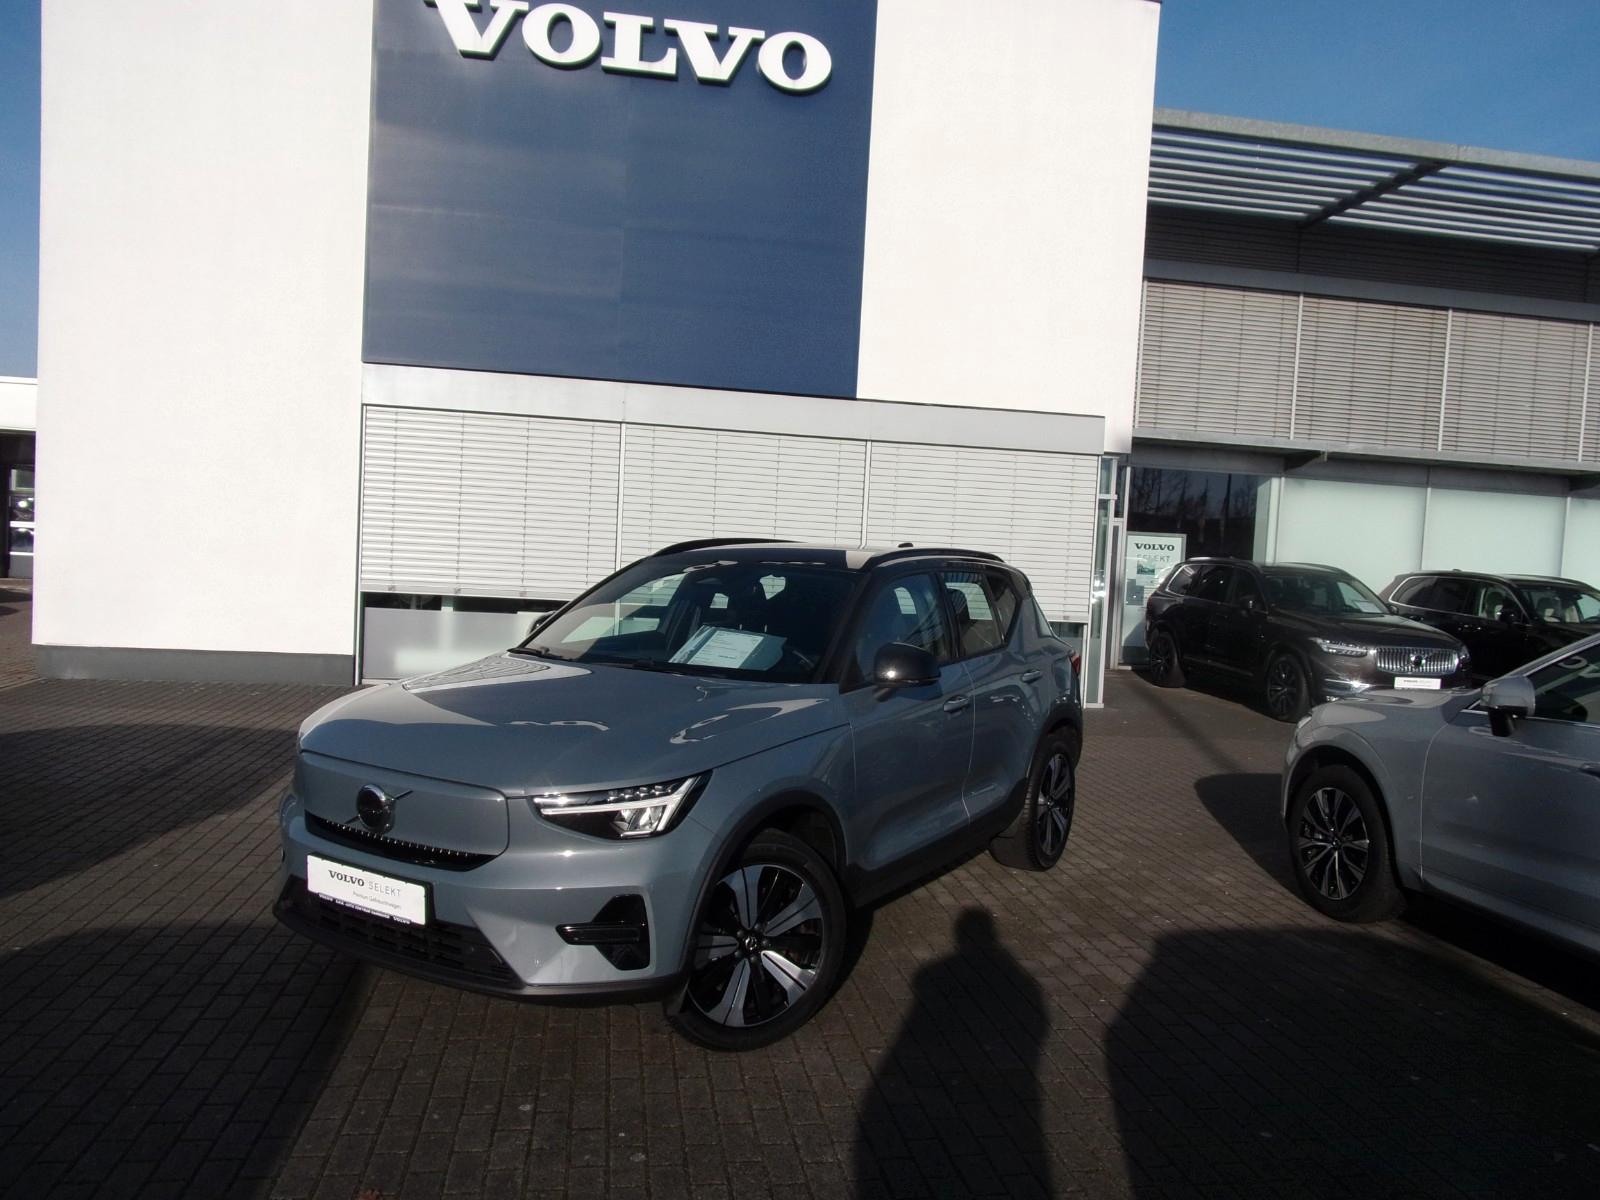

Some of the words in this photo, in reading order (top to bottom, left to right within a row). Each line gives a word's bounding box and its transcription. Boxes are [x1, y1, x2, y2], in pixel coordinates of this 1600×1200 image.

[423, 0, 833, 95] VOLVO
[1134, 542, 1175, 552] VOLVO
[328, 869, 365, 887] VOLVO
[368, 880, 401, 897] SELEKT
